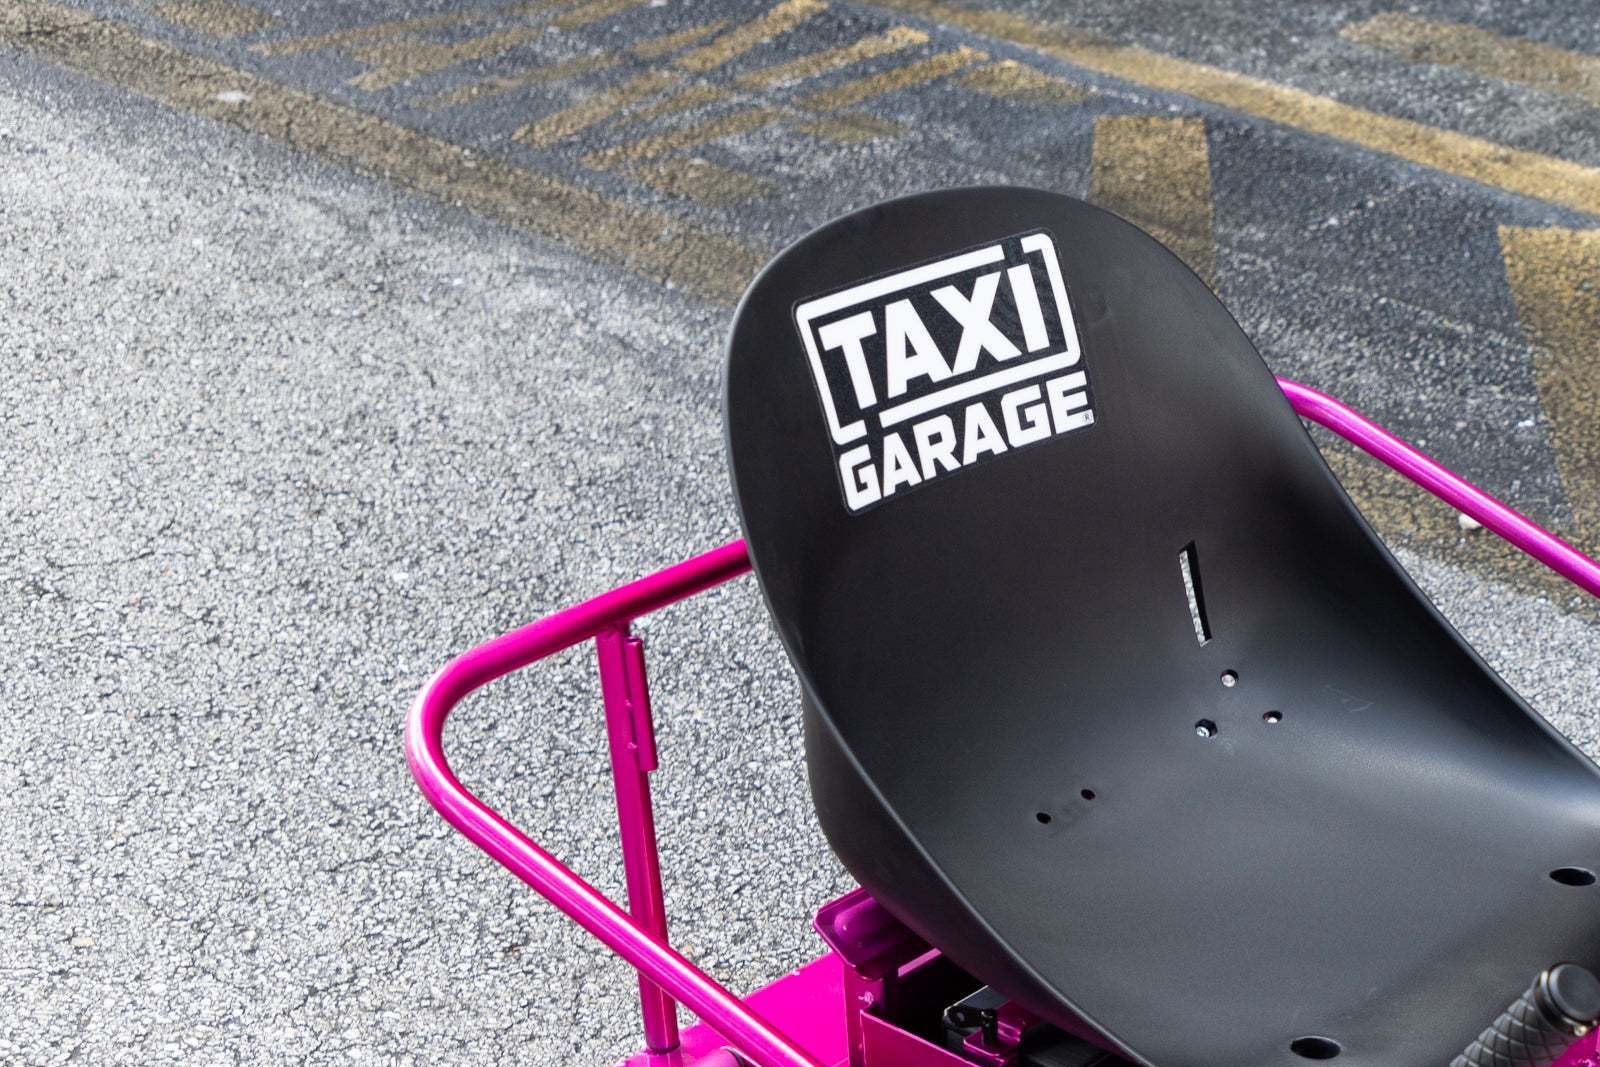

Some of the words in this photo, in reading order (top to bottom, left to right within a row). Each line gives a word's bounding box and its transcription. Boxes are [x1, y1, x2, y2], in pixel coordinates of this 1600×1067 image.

[148, 0, 1092, 202] ANE
[818, 263, 1050, 410] TAXI
[839, 370, 1094, 511] GARAGE
